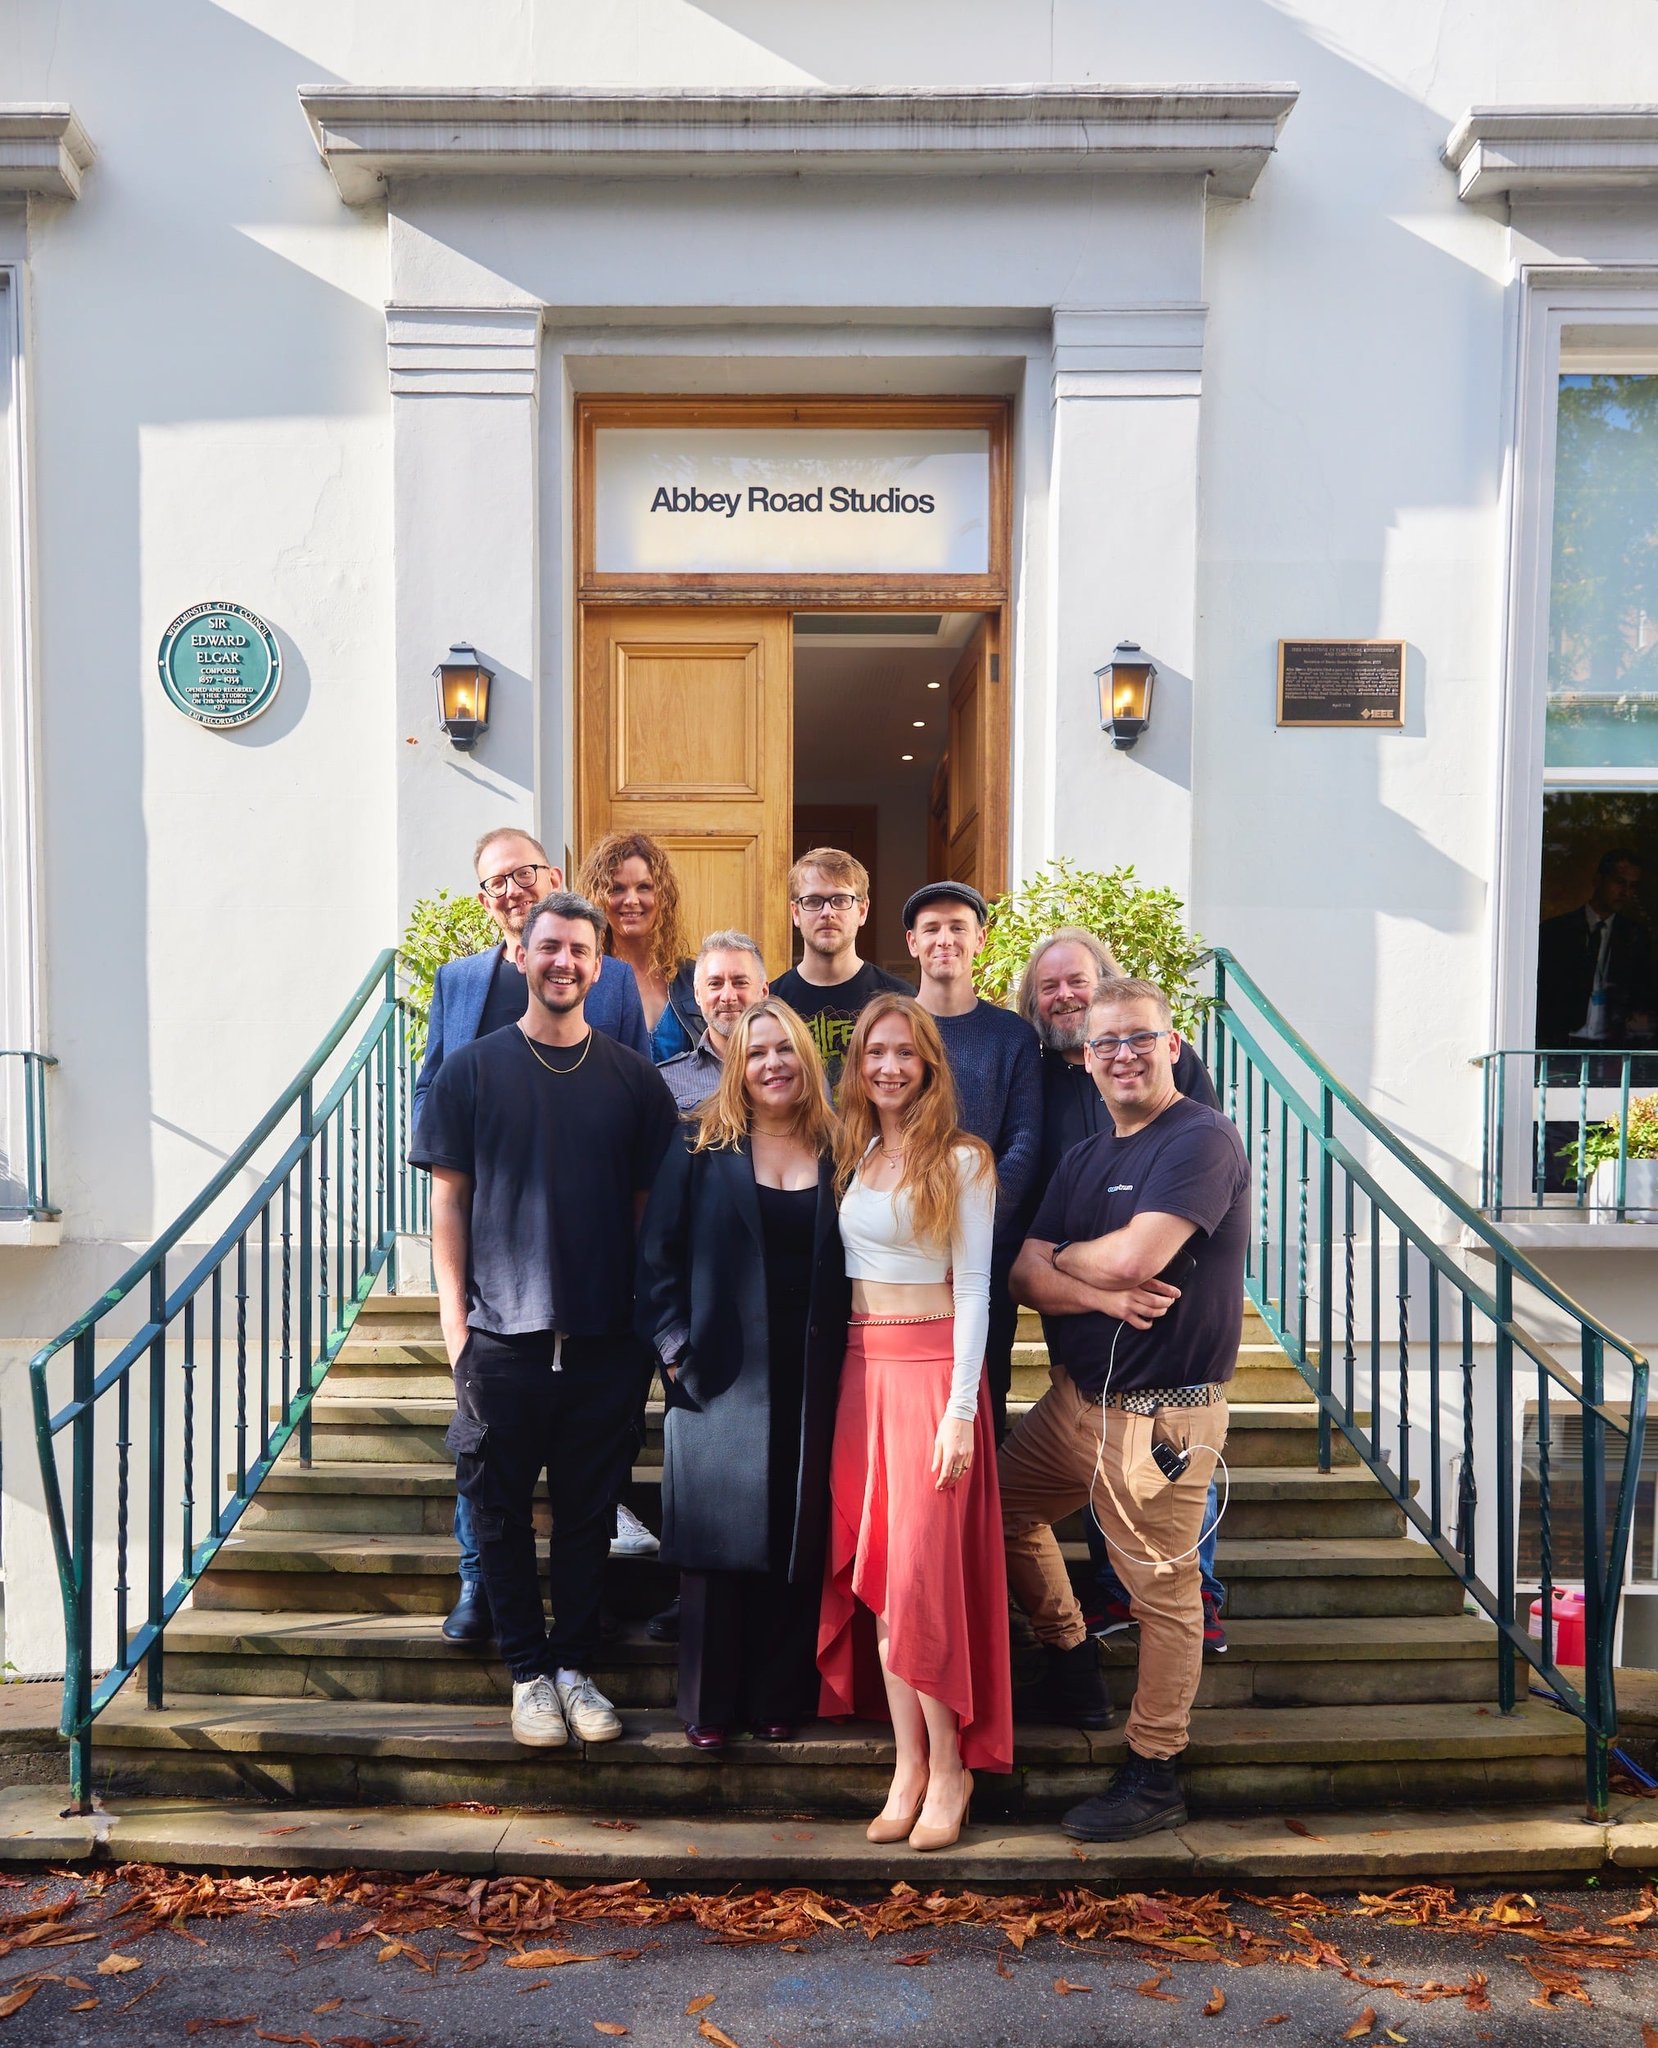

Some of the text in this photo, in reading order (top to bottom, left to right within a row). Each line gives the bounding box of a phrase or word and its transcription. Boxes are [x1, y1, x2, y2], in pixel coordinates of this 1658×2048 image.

[650, 486, 936, 518] Abbey Road Studios
[166, 603, 270, 637] WESTMINSTER CITY COUNCIL
[208, 618, 227, 629] SIR
[191, 635, 246, 646] EDWARD
[196, 652, 240, 663] ELGAR
[188, 710, 201, 721] EMI
[202, 716, 235, 725] RECORDS
[1371, 709, 1394, 718] IEEE
